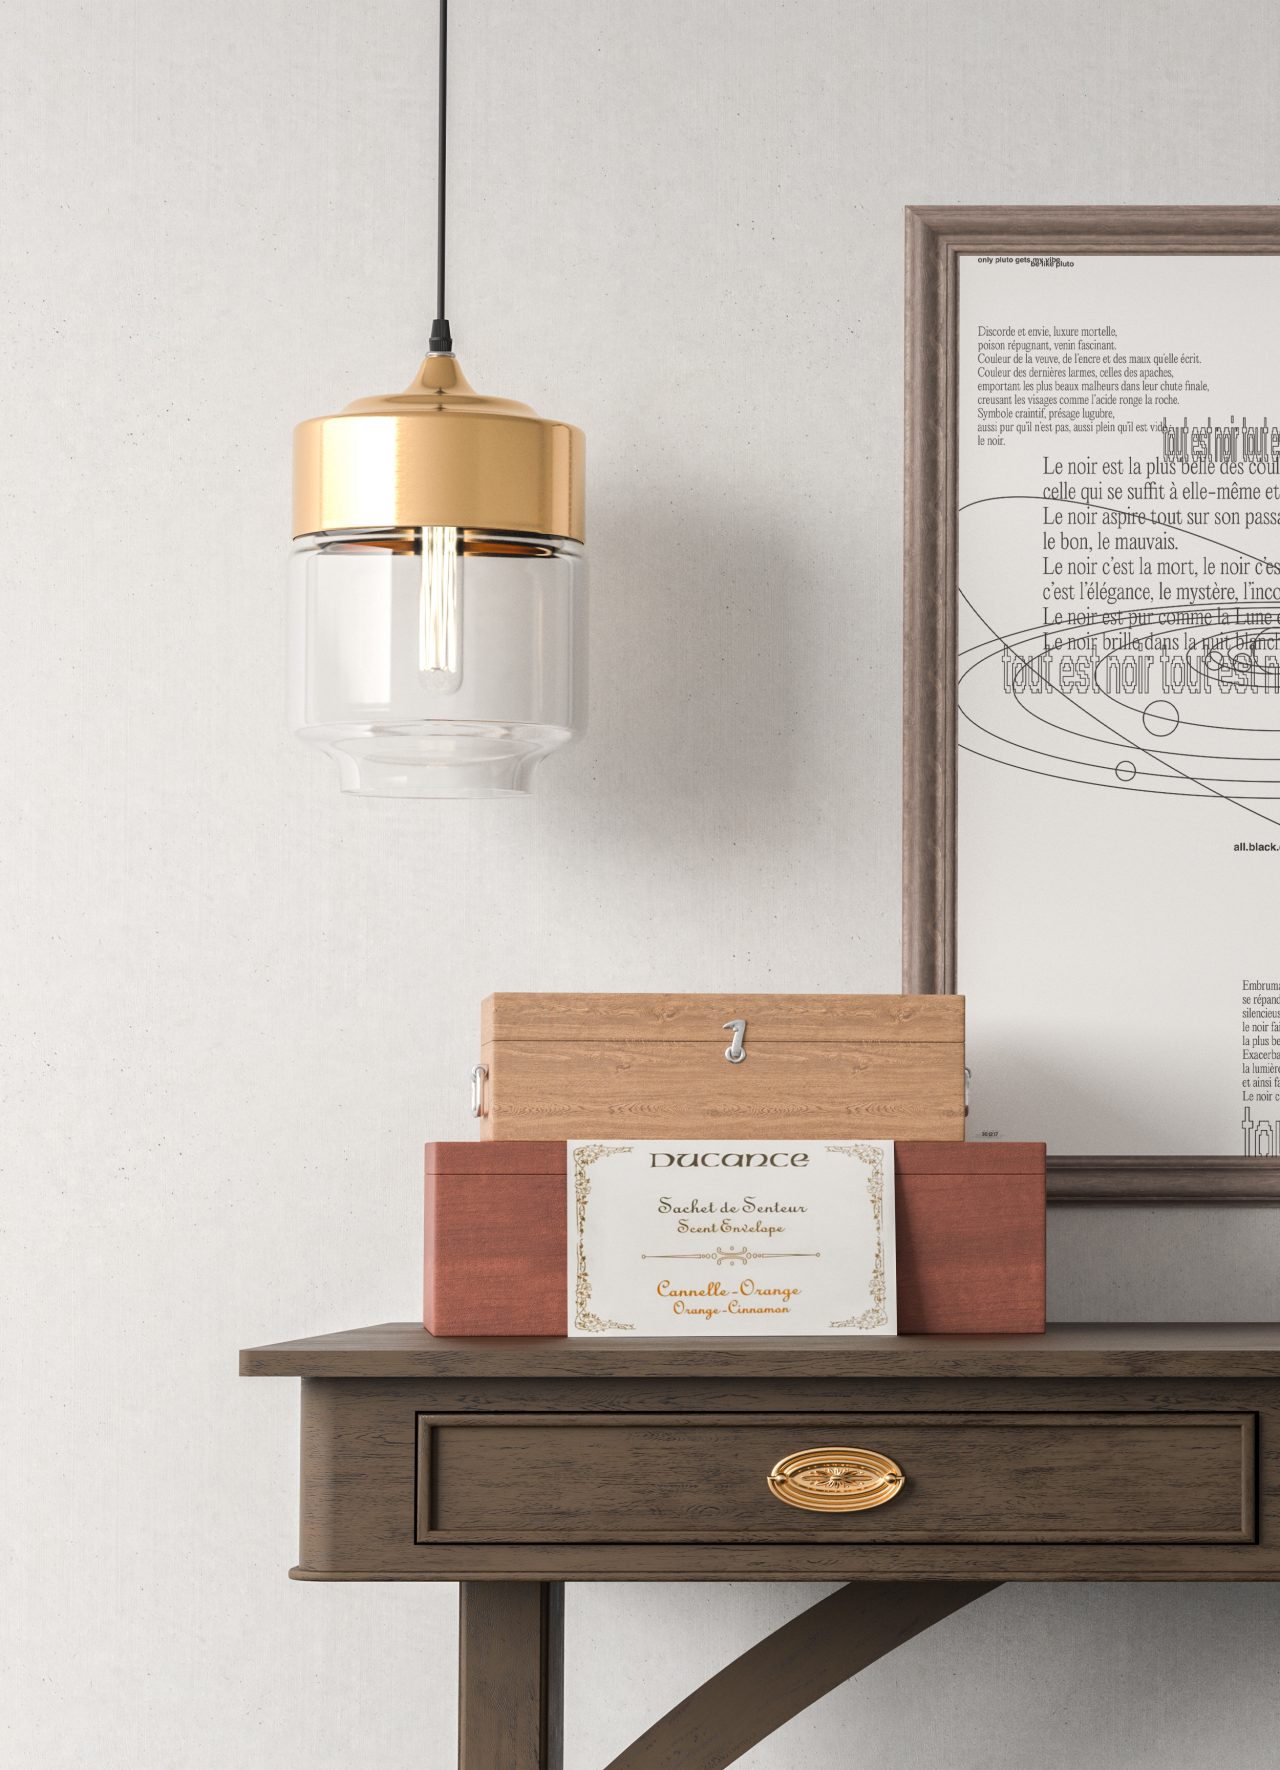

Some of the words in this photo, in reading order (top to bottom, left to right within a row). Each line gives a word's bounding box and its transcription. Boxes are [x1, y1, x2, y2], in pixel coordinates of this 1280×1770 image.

[978, 256, 993, 264] only
[995, 256, 1014, 264] pluto
[1056, 260, 1075, 269] pluto
[978, 325, 1015, 337] Discorde
[1018, 327, 1026, 337] et
[1028, 325, 1051, 338] envie,
[1054, 325, 1079, 337] luxure
[1081, 325, 1117, 338] mortelle,
[978, 339, 1005, 354] poison
[1054, 339, 1075, 351] venin
[1078, 339, 1116, 351] fascinant.
[978, 366, 1011, 378] Couleur
[1013, 366, 1026, 378] des
[1029, 366, 1066, 378] dernières
[1069, 366, 1097, 379] larmes,
[1100, 366, 1122, 378] celles
[1124, 366, 1138, 378] des
[1140, 366, 1173, 381] apaches,
[978, 382, 1021, 395] emportant
[1023, 380, 1034, 392] les
[1036, 380, 1052, 395] plus
[1055, 380, 1078, 392] beaux
[1082, 380, 1119, 392] malheurs
[1121, 380, 1140, 392] dans
[1143, 380, 1158, 392] leur
[1160, 380, 1182, 392] chute
[1185, 380, 1209, 393] finale,
[978, 407, 1013, 422] Symbole
[1015, 407, 1046, 420] craintif,
[1049, 407, 1080, 422] présage
[1083, 407, 1114, 422] lugubre,
[1044, 456, 1063, 475] Le
[1068, 456, 1097, 475] noir
[1103, 459, 1123, 475] est
[1129, 456, 1141, 475] la
[1146, 456, 1177, 480] plus
[1181, 456, 1216, 475] belle
[1219, 456, 1245, 475] des
[1043, 481, 1076, 500] celle
[1081, 481, 1102, 505] qui
[1108, 486, 1122, 500] se
[1128, 481, 1165, 500] suffit
[1170, 481, 1177, 500] à
[1183, 481, 1260, 500] elle-même
[1266, 484, 1280, 500] et
[1044, 506, 1062, 525] Le
[1068, 506, 1098, 525] noir
[1102, 506, 1147, 530] aspire
[1150, 509, 1183, 525] tout
[1187, 511, 1209, 525] sur
[1215, 511, 1240, 525] son
[1044, 531, 1055, 550] le
[1061, 531, 1092, 553] bon,
[1098, 531, 1110, 550] le
[1115, 531, 1177, 550] mauvais.
[1160, 581, 1171, 600] le
[1243, 1020, 1250, 1032] le
[1252, 1020, 1268, 1032] noir
[657, 1196, 717, 1214] Sachet
[720, 1199, 738, 1214] de
[742, 1196, 808, 1214] Senteur
[677, 1219, 717, 1233] Scent
[719, 1218, 786, 1237] Envelope
